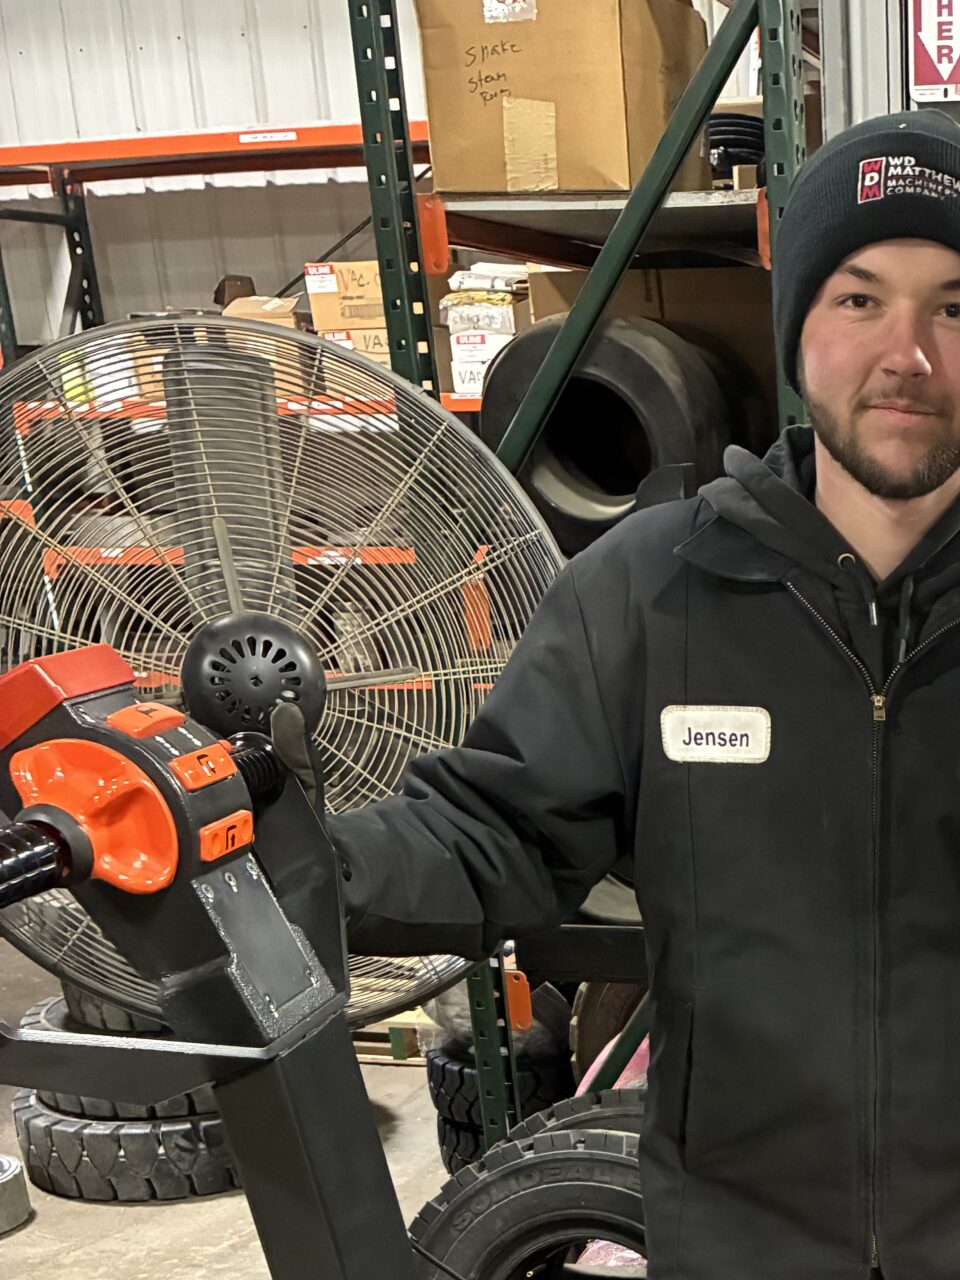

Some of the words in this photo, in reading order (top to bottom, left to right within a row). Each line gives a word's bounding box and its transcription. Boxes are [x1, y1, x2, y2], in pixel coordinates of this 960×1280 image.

[937, 0, 954, 64] HER
[888, 156, 916, 167] WD
[362, 334, 388, 350] VA
[682, 727, 749, 747] Jensen
